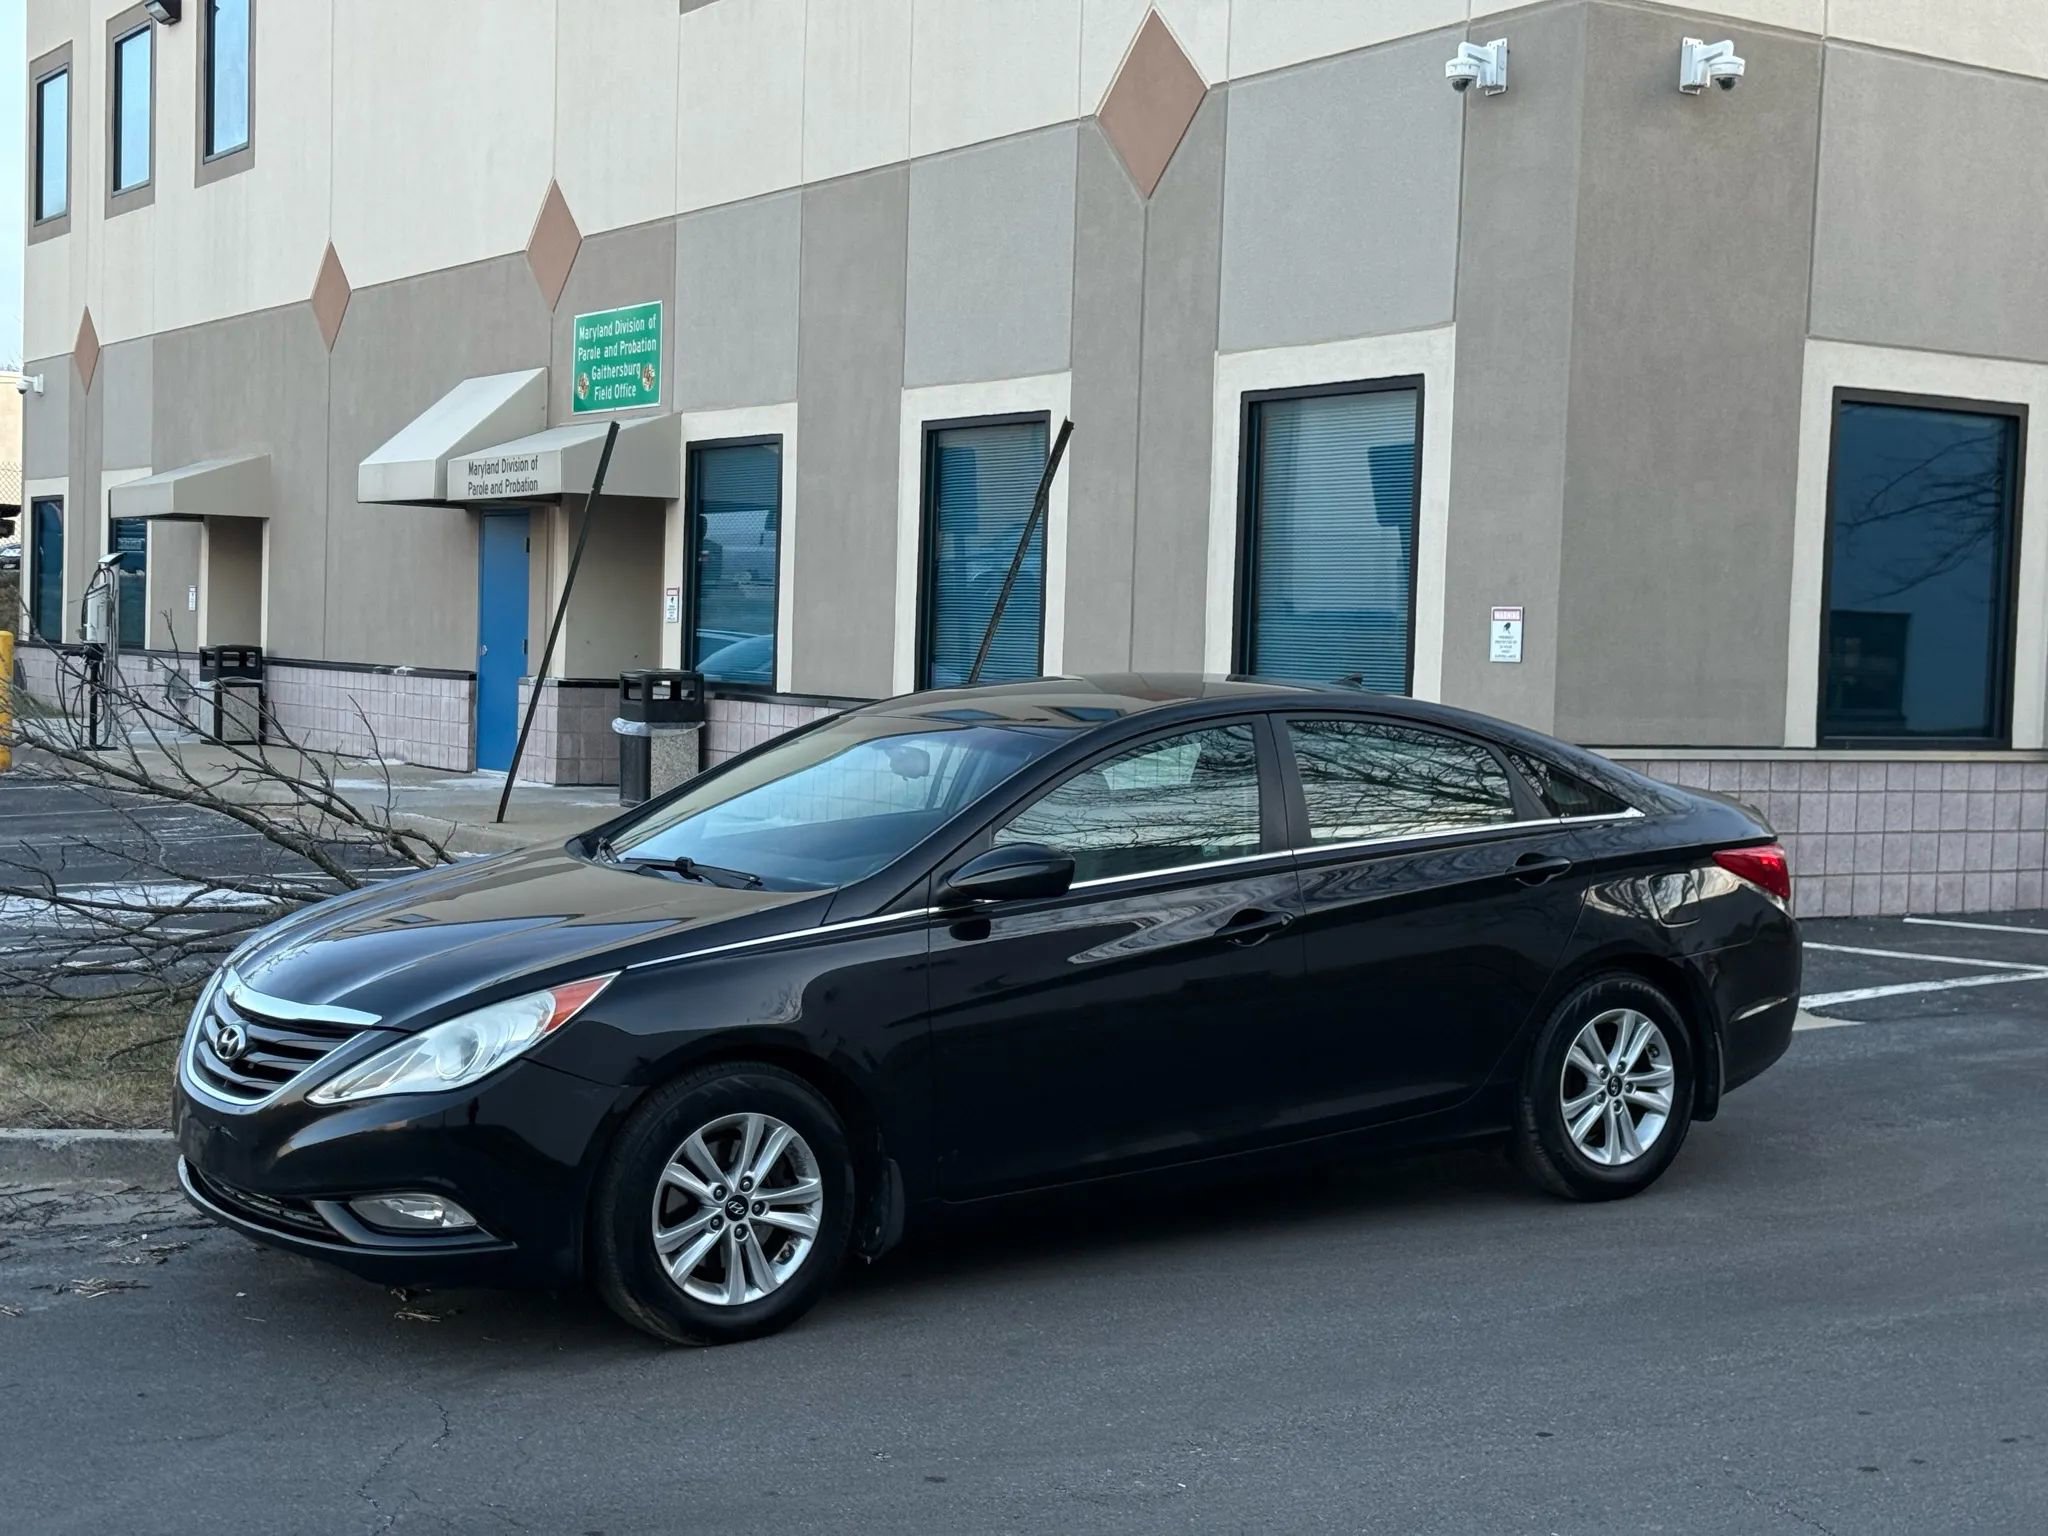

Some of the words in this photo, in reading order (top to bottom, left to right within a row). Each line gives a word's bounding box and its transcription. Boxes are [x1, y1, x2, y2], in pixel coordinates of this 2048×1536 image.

[579, 320, 612, 342] Maryland
[615, 317, 644, 336] Division
[648, 313, 657, 329] of
[578, 345, 600, 361] Parole
[604, 342, 618, 358] and
[620, 337, 656, 356] Probation
[592, 363, 640, 380] Gaithersburg
[594, 384, 612, 400] Field
[615, 383, 636, 398] Office
[468, 460, 499, 478] Maryland
[502, 456, 528, 473] Division
[531, 455, 538, 470] of
[468, 481, 488, 496] Parole
[490, 479, 503, 494] and
[505, 477, 538, 494] Probation
